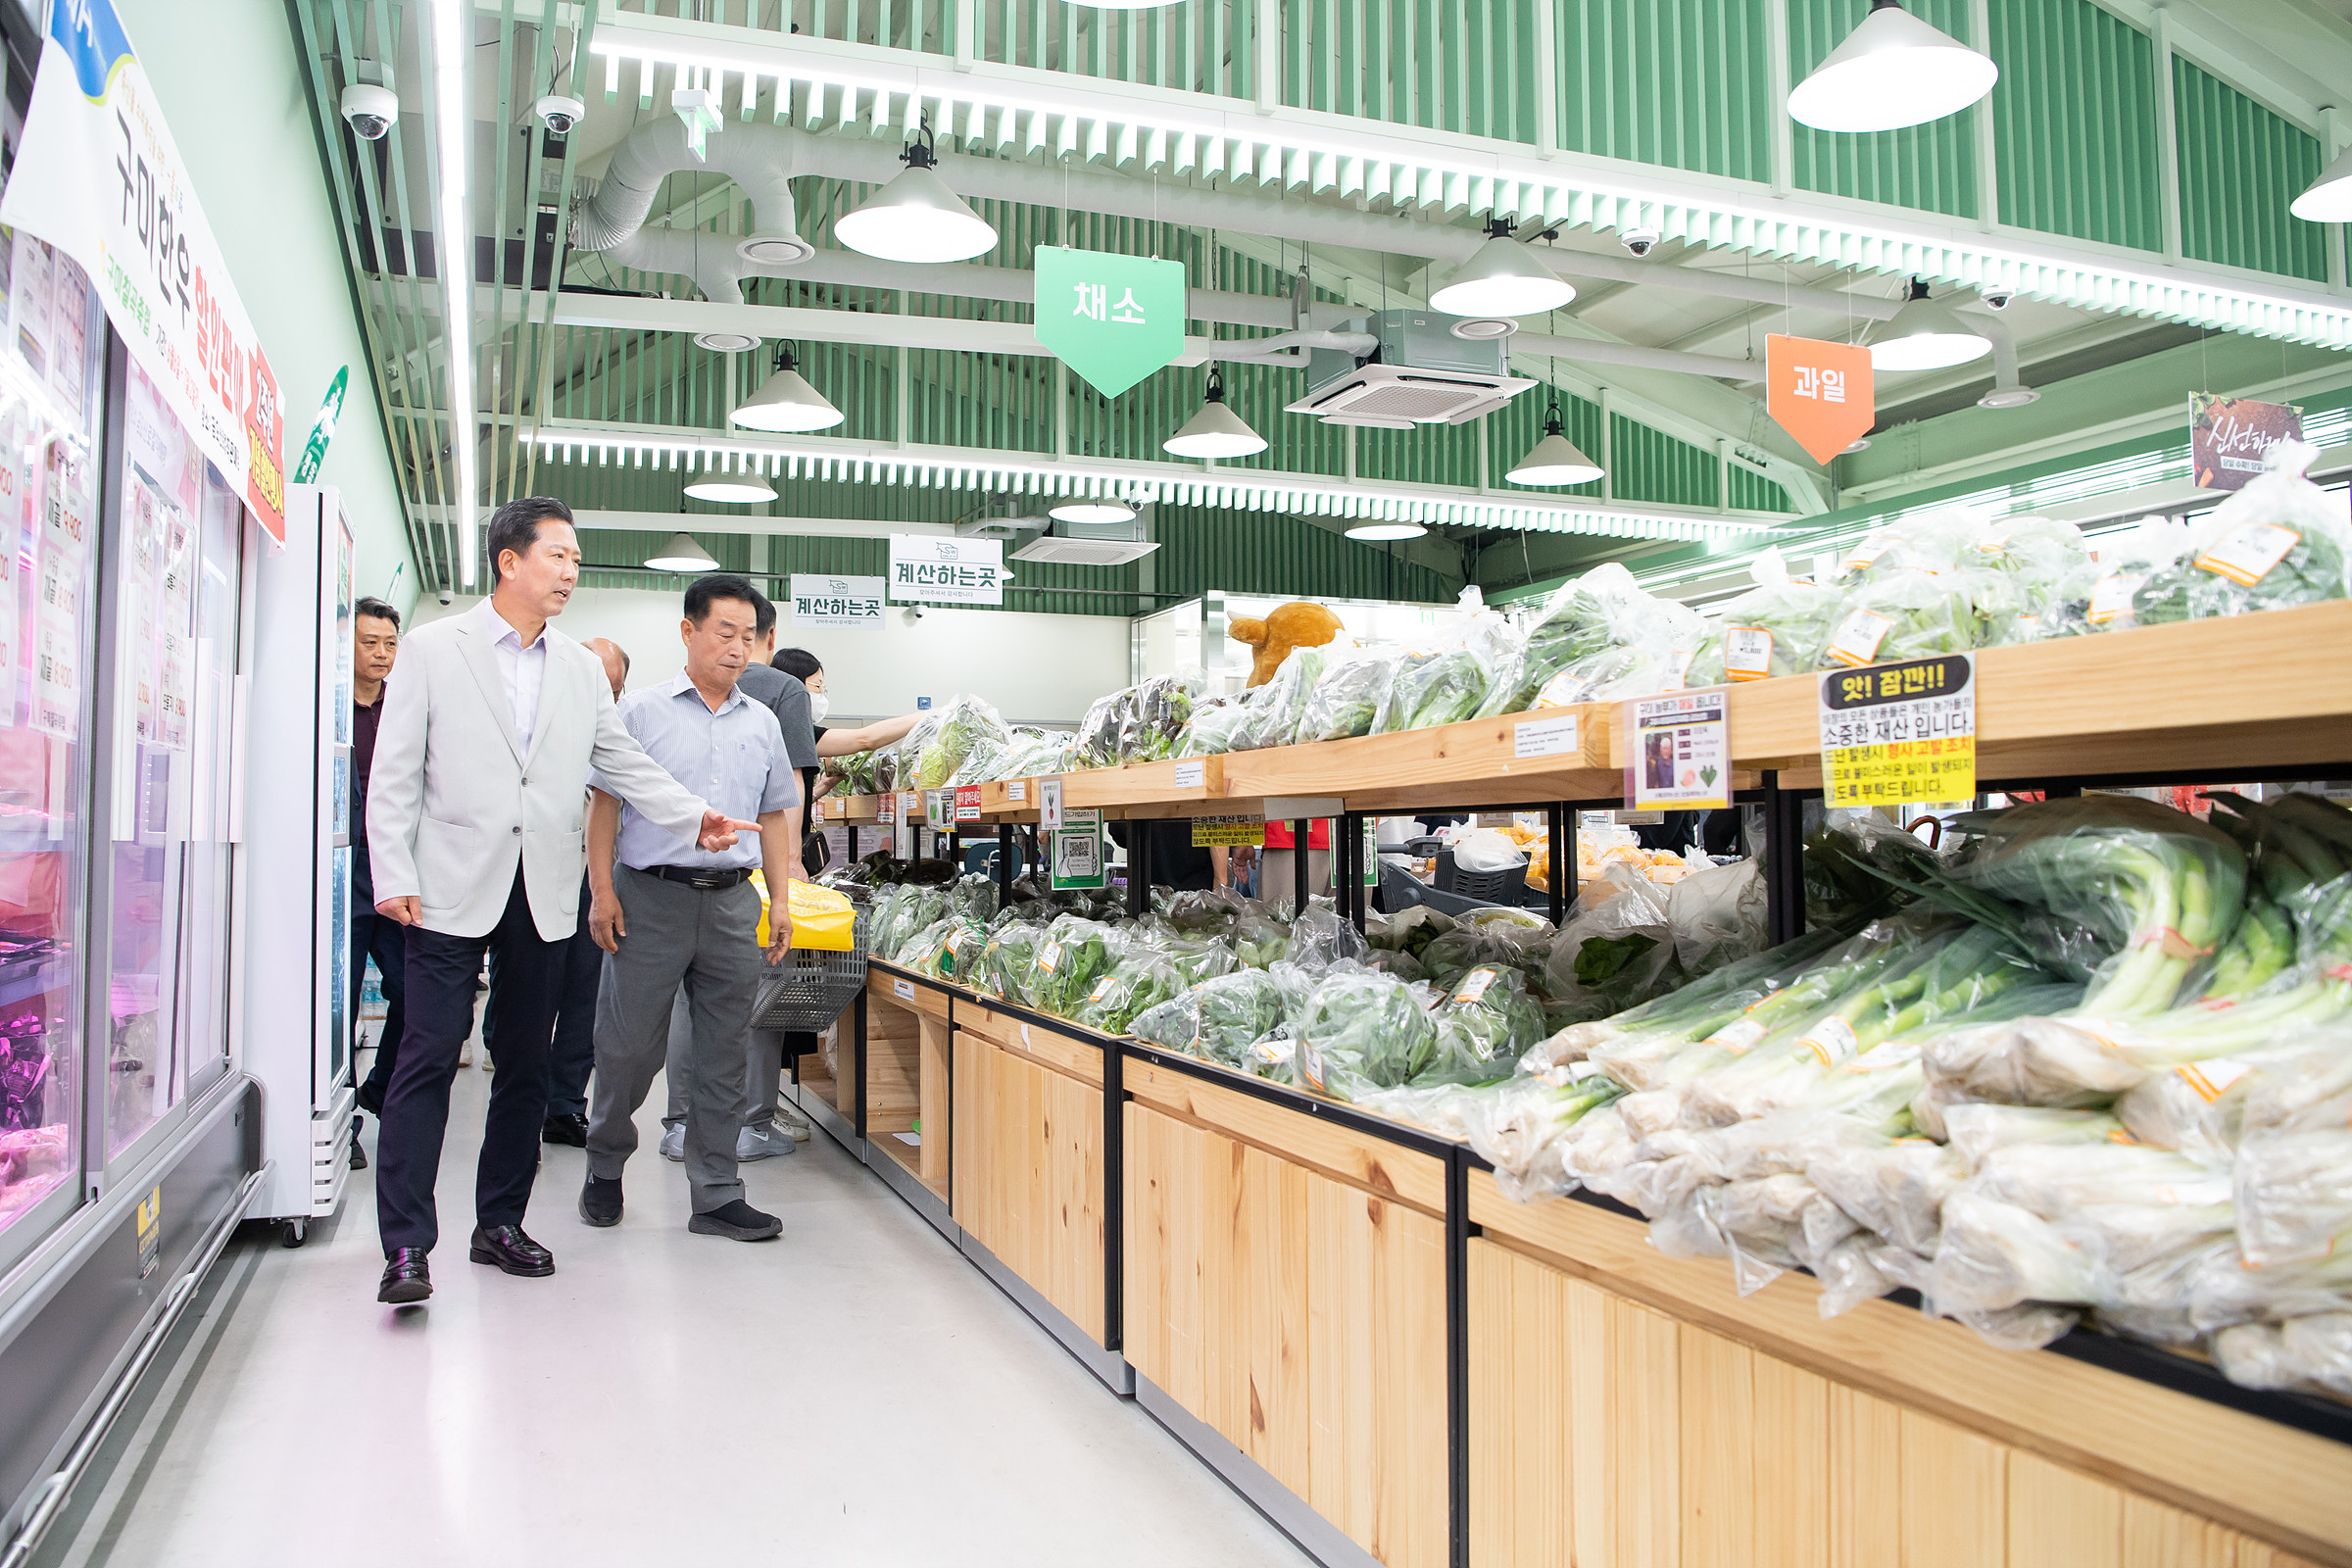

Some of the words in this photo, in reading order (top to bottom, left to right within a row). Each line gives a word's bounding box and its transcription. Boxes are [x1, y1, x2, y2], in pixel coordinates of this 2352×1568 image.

[116, 105, 190, 330] 구미한우
[196, 265, 243, 433] 할인판매
[107, 253, 151, 337] 구미칠곡축협
[1073, 281, 1146, 324] 채소
[1793, 366, 1845, 403] 과일
[256, 365, 274, 454] 2주년
[2206, 416, 2291, 454] 신선하
[896, 563, 997, 588] 계산하는곳
[795, 597, 880, 616] 계산하는곳
[1841, 674, 1873, 703] 앗!
[1879, 662, 1944, 697] 잠깐!!
[1823, 721, 1869, 747] 소중한
[1875, 718, 1909, 742] 재산
[1915, 710, 1974, 739] 입니다.
[1825, 748, 1845, 764] 도난
[1848, 746, 1885, 763] 발생시
[1887, 741, 1913, 760] 형사
[1916, 739, 1943, 756] 고발
[1946, 736, 1972, 753] 조치
[1862, 779, 1945, 800] 부탁드립니다.
